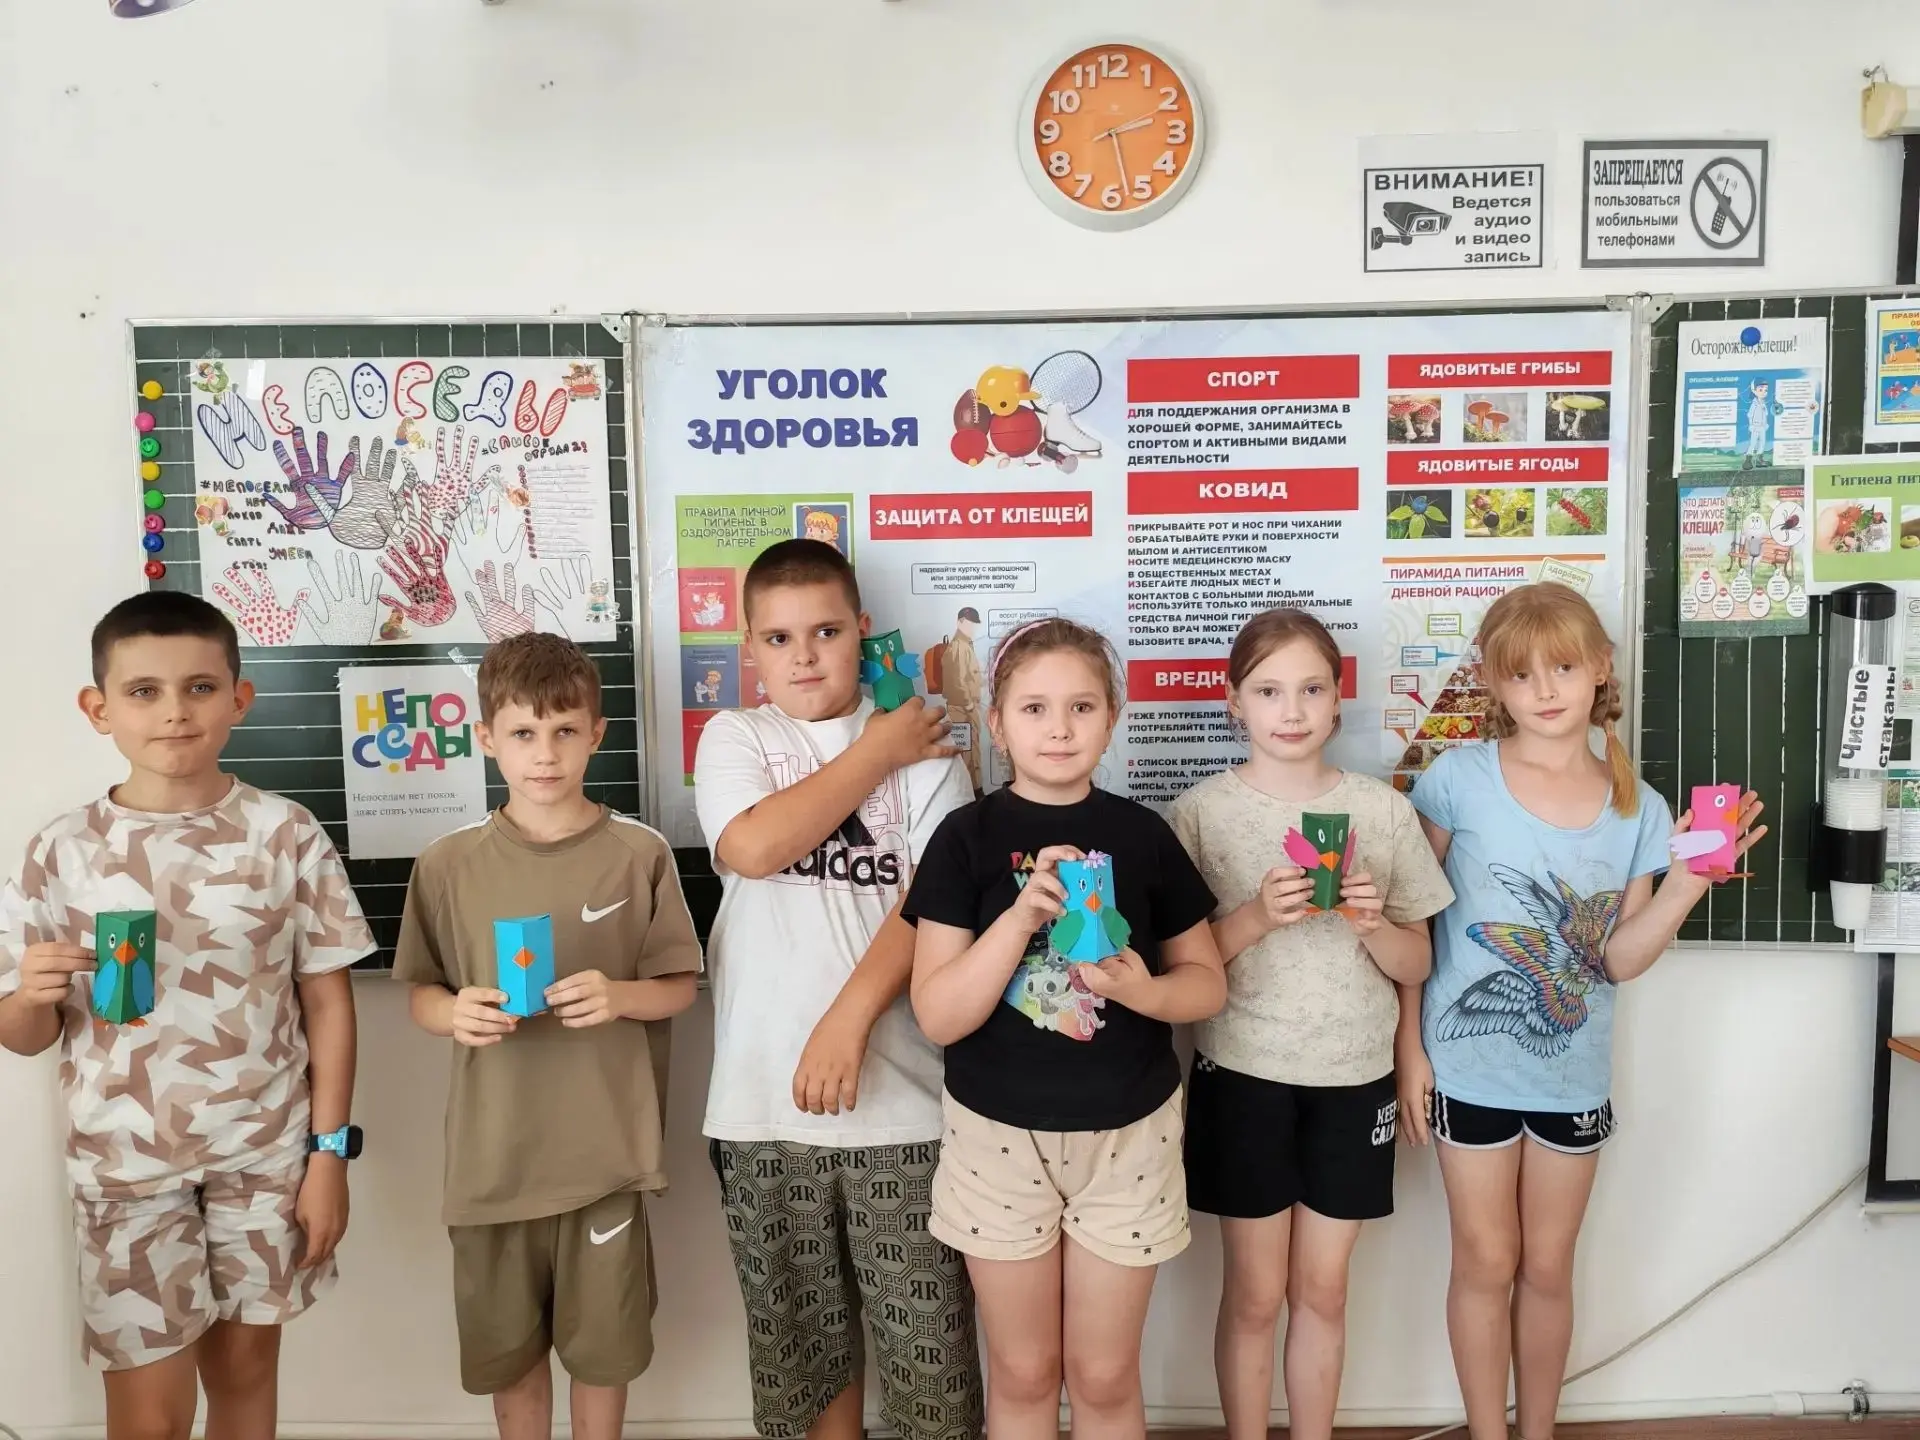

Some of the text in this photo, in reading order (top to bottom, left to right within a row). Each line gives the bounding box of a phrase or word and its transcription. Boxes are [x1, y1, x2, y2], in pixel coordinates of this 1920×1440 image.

[1097, 53, 1129, 78] 12
[1071, 64, 1096, 88] 11
[1140, 64, 1151, 87] 1
[1049, 89, 1081, 114] 10
[1158, 87, 1179, 111] 2
[1039, 119, 1060, 144] 9
[1166, 119, 1186, 144] 3
[1049, 151, 1071, 177] 8
[1152, 150, 1176, 176] 4
[1374, 171, 1534, 191] ВНИМАНИЕ!
[1593, 159, 1684, 189] ЗАПРЕЩАЕТСЯ
[1074, 173, 1092, 198] 7
[1132, 174, 1152, 199] 5
[1101, 184, 1122, 209] 6
[1452, 196, 1532, 210] Ведется
[1594, 194, 1681, 208] пользоваться
[1474, 214, 1532, 229] аудио
[1596, 213, 1678, 227] мобильными
[1455, 231, 1532, 247] и видео
[1597, 233, 1676, 249] телефонами
[1464, 250, 1531, 264] запись
[1892, 312, 1920, 320] ПРАВИ
[1419, 360, 1581, 378] ЯДОВИТЫЕ ГРИБЫ
[716, 368, 888, 400] УГОЛОК
[1207, 370, 1280, 387] СПОРТ
[1128, 403, 1351, 419] ДЛЯ ПОДДЕРЖАНИЯ ОРГАНИЗМА В
[1128, 419, 1343, 433] ХОРОШЕЙ ФОРМЕ, ЗАНИМАЙТЕСЬ
[687, 416, 919, 455] ЗДОРОВЬЯ
[1128, 435, 1347, 449] СПОРТОМ И АКТИВНЫМИ ВИДАМИ
[1128, 453, 1230, 466] ДЕЯТЕЛЬНОСТИ
[1418, 456, 1579, 474] ЯДОВИТЫЕ ЯГОДЫ
[1831, 474, 1892, 487] Гигиена
[1199, 481, 1288, 499] КОВИД
[1683, 498, 1725, 508] ЧТО ДЕЛАТЬ
[685, 505, 786, 517] ПРАВИЛА ЛИЧНОЙ
[875, 503, 1088, 528] ЗАЩИТА ОТ КЛЕЩЕЙ
[1683, 509, 1724, 519] ПРИ УКУСЕ
[704, 518, 767, 527] ГИГИЕНЫ В
[1128, 521, 1206, 531] ПРИКРЫВАЙТЕ
[1208, 522, 1229, 530] РОТ
[1242, 521, 1264, 529] НОС
[1291, 520, 1342, 528] ЧИХАНИИ
[1682, 521, 1724, 536] КЛЕЩА?
[680, 528, 792, 538] ОЗДОРОВИТЕЛЬНОМ
[1128, 533, 1219, 543] ОБРАБАТЫВАЙТЕ
[1222, 533, 1249, 542] РУКИ
[1262, 532, 1339, 540] ПОВЕРХНОСТИ
[717, 538, 756, 548] ЛАГЕРЕ
[1128, 547, 1168, 555] МЫЛОМ
[1182, 545, 1267, 555] АНТИСЕПТИКОМ
[1128, 555, 1292, 566] НОСИТЕ МЕДЕЦИНСКУЮ МАСКУ
[1137, 569, 1226, 579] ОБЩЕСТВЕННЫХ
[1229, 568, 1272, 576] МЕСТАХ
[1390, 566, 1525, 580] ПИРАМИДА ПИТАНИЯ
[1128, 579, 1188, 588] ИЗБЕГАЙТЕ
[1190, 579, 1239, 588] ЛЮДНЫХ
[1242, 578, 1270, 586] МЕСТ
[1128, 592, 1189, 600] КОНТАКТОВ
[1202, 590, 1264, 599] БОЛЬНЫМИ
[1266, 589, 1314, 598] ЛЮДЬМИ
[1391, 584, 1506, 599] ДНЕВНОЙ РАЦИОН
[1128, 598, 1353, 610] ИСПОЛЬЗУЙТЕ ТОЛЬКО ИНДИВИДУАЛЬНЫЕ
[1128, 612, 1229, 623] СРЕДСТВА ЛИЧНОЙ
[1129, 624, 1241, 633] ТОЛЬКО ВРАЧ МОЖЕТ
[1128, 637, 1185, 646] ВЫЗОВИТЕ
[1187, 637, 1225, 645] ВРАЧА,
[1155, 670, 1226, 688] ВРЕДН
[355, 688, 466, 732] НЕПО
[1128, 710, 1229, 720] РЕЖЕ УПОТРЕБЛЯЙТ
[1841, 669, 1869, 760] Чистые
[1879, 666, 1896, 768] стаканы
[1128, 722, 1205, 732] УПОТРЕБЛЯЙТЕ
[1128, 735, 1205, 745] СОДЕРЖАНИЕМ
[1208, 735, 1239, 744] СОЛИ,
[1137, 758, 1178, 767] СПИСОК
[1180, 756, 1228, 766] ВРЕДНОЙ
[1128, 770, 1188, 779] ГАЗИРОВКА,
[1128, 781, 1198, 791] ЧИПСЫ, СУХА
[1128, 793, 1179, 802] КАРТОШК
[443, 804, 467, 813] стоя!
[780, 840, 900, 886] didas
